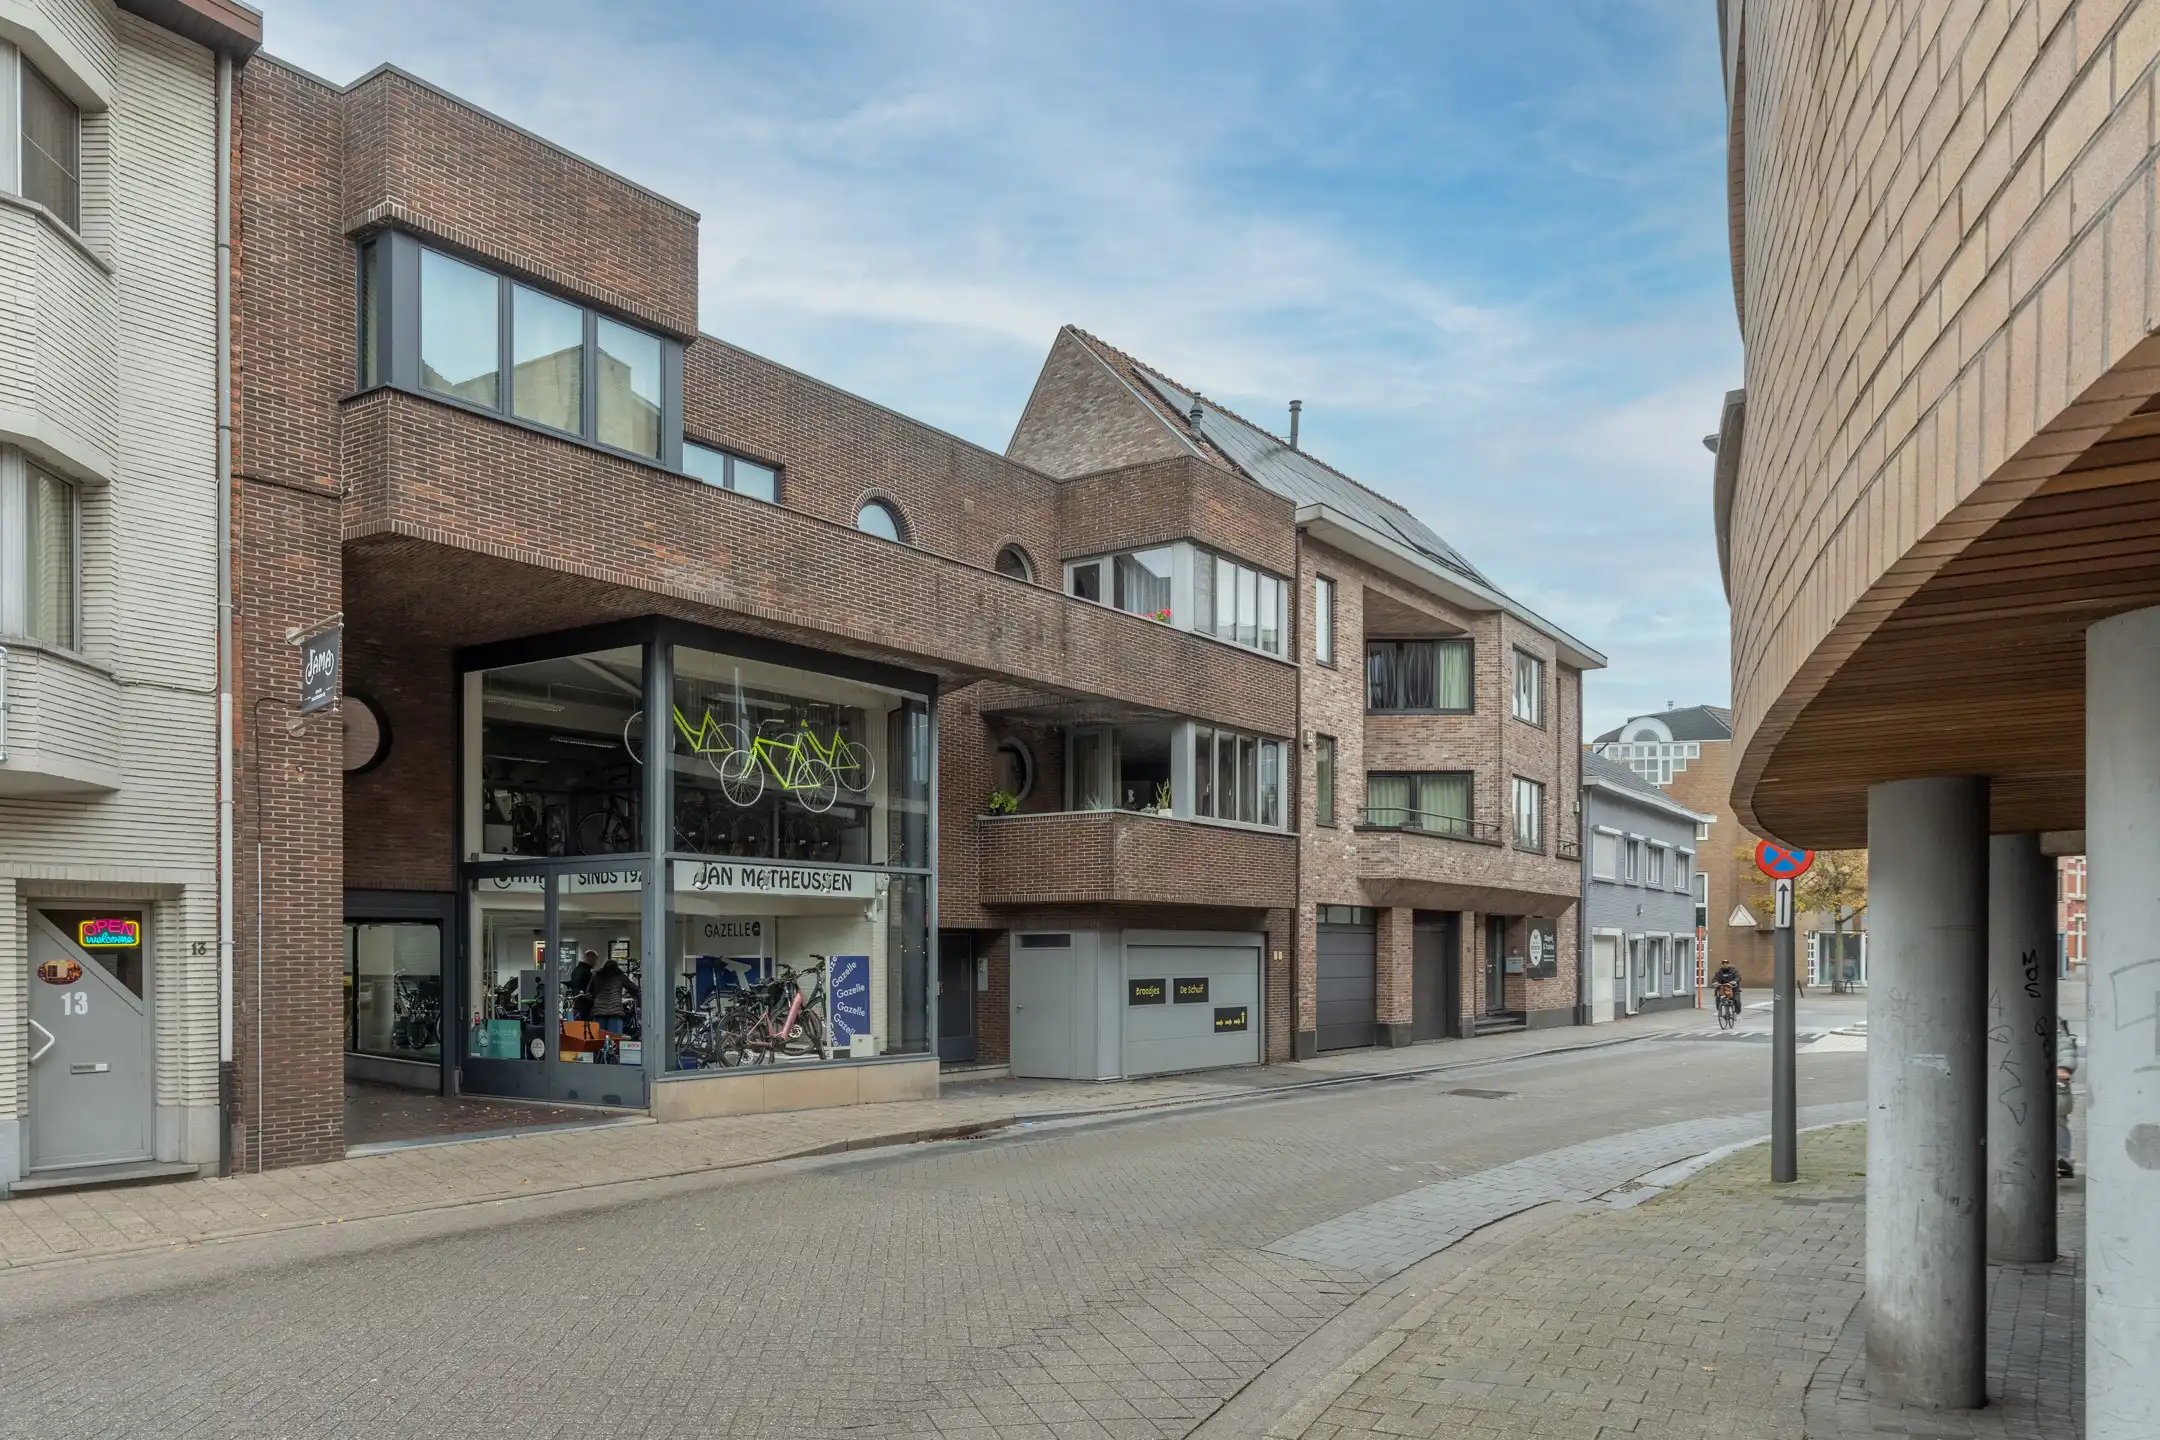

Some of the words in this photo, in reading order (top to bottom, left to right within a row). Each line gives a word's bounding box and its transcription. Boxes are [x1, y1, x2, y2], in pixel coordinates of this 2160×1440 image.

[578, 871, 618, 885] SINDS
[693, 863, 733, 890] JAN
[84, 919, 135, 936] OPEN
[705, 922, 751, 938] GAZELLE
[86, 931, 135, 944] welcome
[191, 941, 206, 956] 13
[832, 962, 857, 987] Gazelle
[837, 984, 866, 998] Gazelle
[1135, 986, 1160, 997] Broodjes
[1180, 985, 1187, 994] De
[1188, 984, 1204, 994] Schuif
[61, 991, 88, 1015] 13
[837, 1001, 866, 1017] Gazelle
